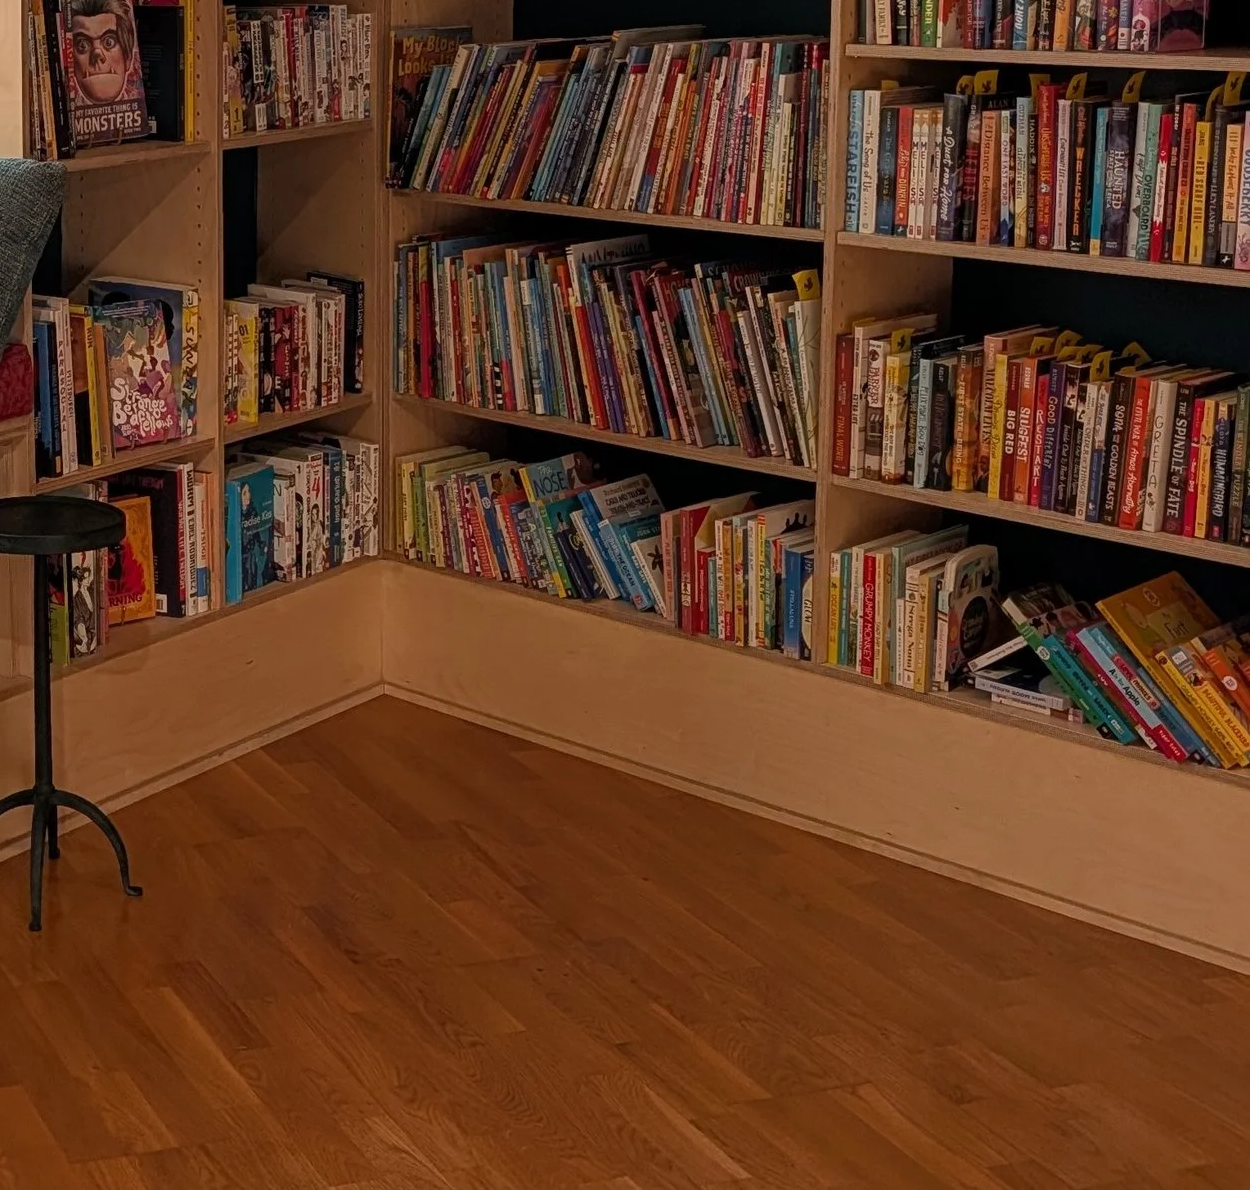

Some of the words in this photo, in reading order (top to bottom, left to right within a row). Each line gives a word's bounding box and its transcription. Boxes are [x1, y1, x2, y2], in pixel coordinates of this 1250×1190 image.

[402, 37, 423, 59] My
[399, 60, 433, 76] Looks
[75, 111, 142, 134] MONSTERS
[85, 106, 112, 117] FAVORITE
[985, 127, 994, 173] Distance
[848, 131, 858, 213] STARFISH
[1112, 150, 1125, 210] HAUNTED
[981, 175, 991, 213] Between
[1139, 175, 1153, 230] OVERBOARD
[111, 378, 167, 412] Strange
[1008, 410, 1016, 428] BIG
[1017, 407, 1031, 463] SLUGFEST
[1005, 431, 1015, 454] RED
[1031, 410, 1043, 487] RESTART
[1148, 416, 1164, 489] GRETA
[1171, 418, 1187, 473] SPINDLE
[533, 471, 568, 498] NOSE
[1105, 479, 1116, 510] BEASTS
[1213, 449, 1227, 518] HUMMINGBIRD
[1167, 485, 1181, 518] FATE
[865, 582, 874, 616] GRUMPY
[862, 618, 873, 662] MONKEY
[1122, 686, 1141, 707] Apple
